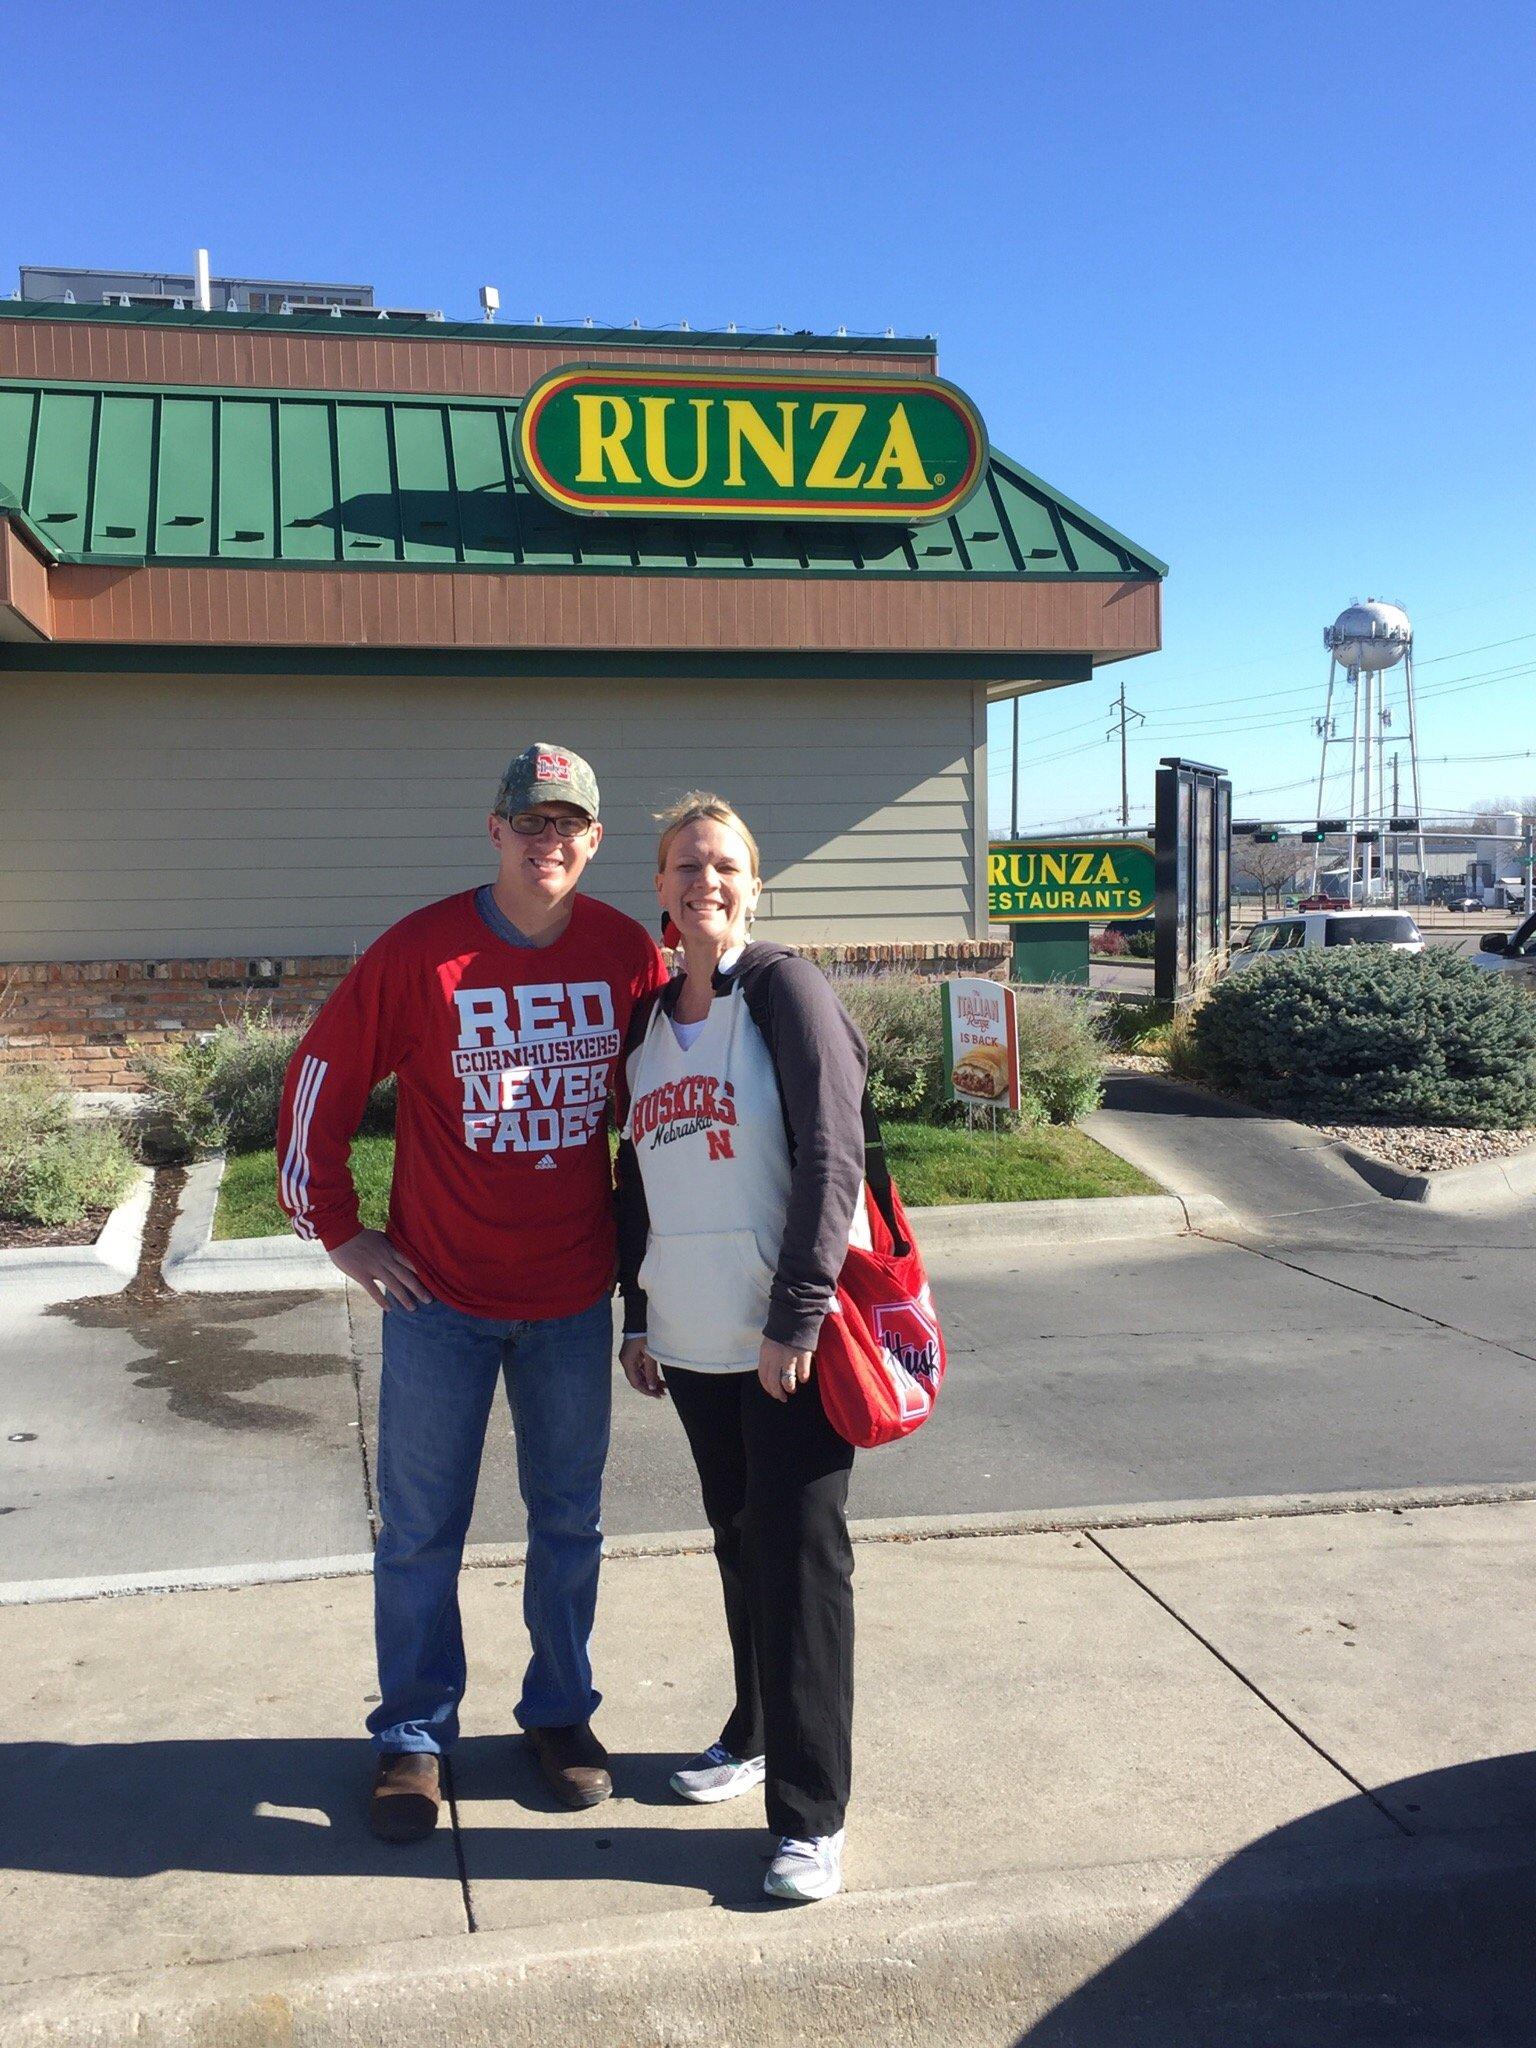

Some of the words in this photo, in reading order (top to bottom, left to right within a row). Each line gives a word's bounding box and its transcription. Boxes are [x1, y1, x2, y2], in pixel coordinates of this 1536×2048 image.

[573, 394, 934, 491] RUNZA
[987, 852, 1120, 887] RUNZA
[987, 890, 1142, 910] ESTAURANTS
[453, 981, 615, 1049] RED
[957, 996, 1000, 1024] ITALIAN
[456, 1034, 618, 1074] CORNHUSKERS
[960, 1032, 970, 1044] IS
[971, 1034, 999, 1048] BACK
[462, 1063, 609, 1111] NEVER
[462, 1100, 606, 1153] FADES
[632, 1074, 738, 1148] HUSKERS
[649, 1114, 713, 1151] Nebraska
[706, 1129, 736, 1161] N
[884, 1330, 939, 1382] Husk
